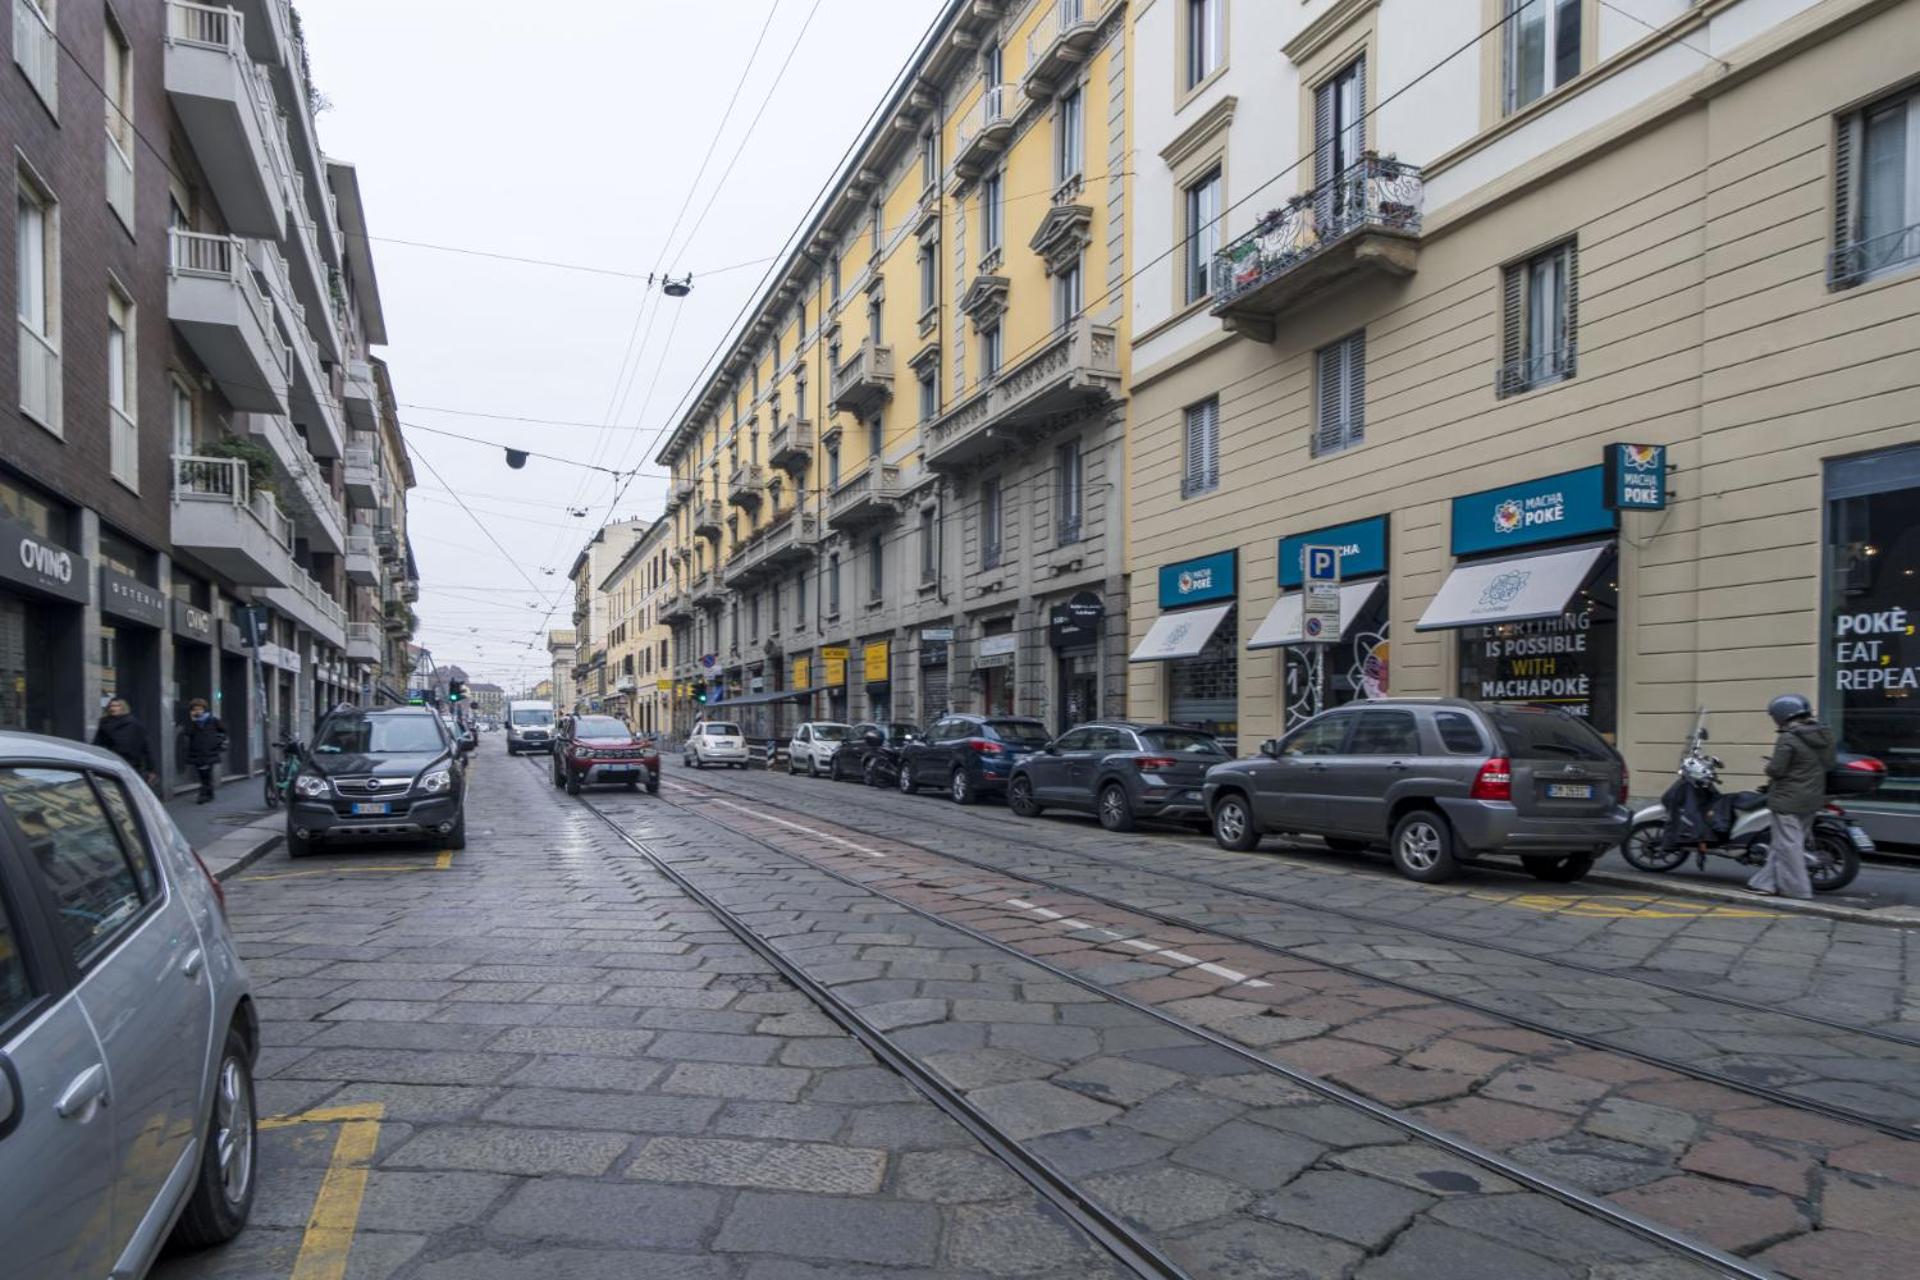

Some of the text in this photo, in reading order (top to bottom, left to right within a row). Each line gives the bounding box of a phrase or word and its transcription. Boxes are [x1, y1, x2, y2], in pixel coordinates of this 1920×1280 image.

[1624, 473, 1657, 486] MACHA
[1525, 492, 1564, 510] MACHA
[1624, 487, 1658, 504] POKÈ
[1525, 504, 1565, 526] POKÈ
[20, 539, 72, 584] OVINO
[1315, 552, 1331, 575] P
[1837, 606, 1915, 636] POKÈ,
[1486, 633, 1586, 658] IS POSSIBLE
[1837, 640, 1892, 666] EAT,
[1511, 657, 1556, 677] WITH
[1481, 674, 1590, 698] MACHAPOKÈ
